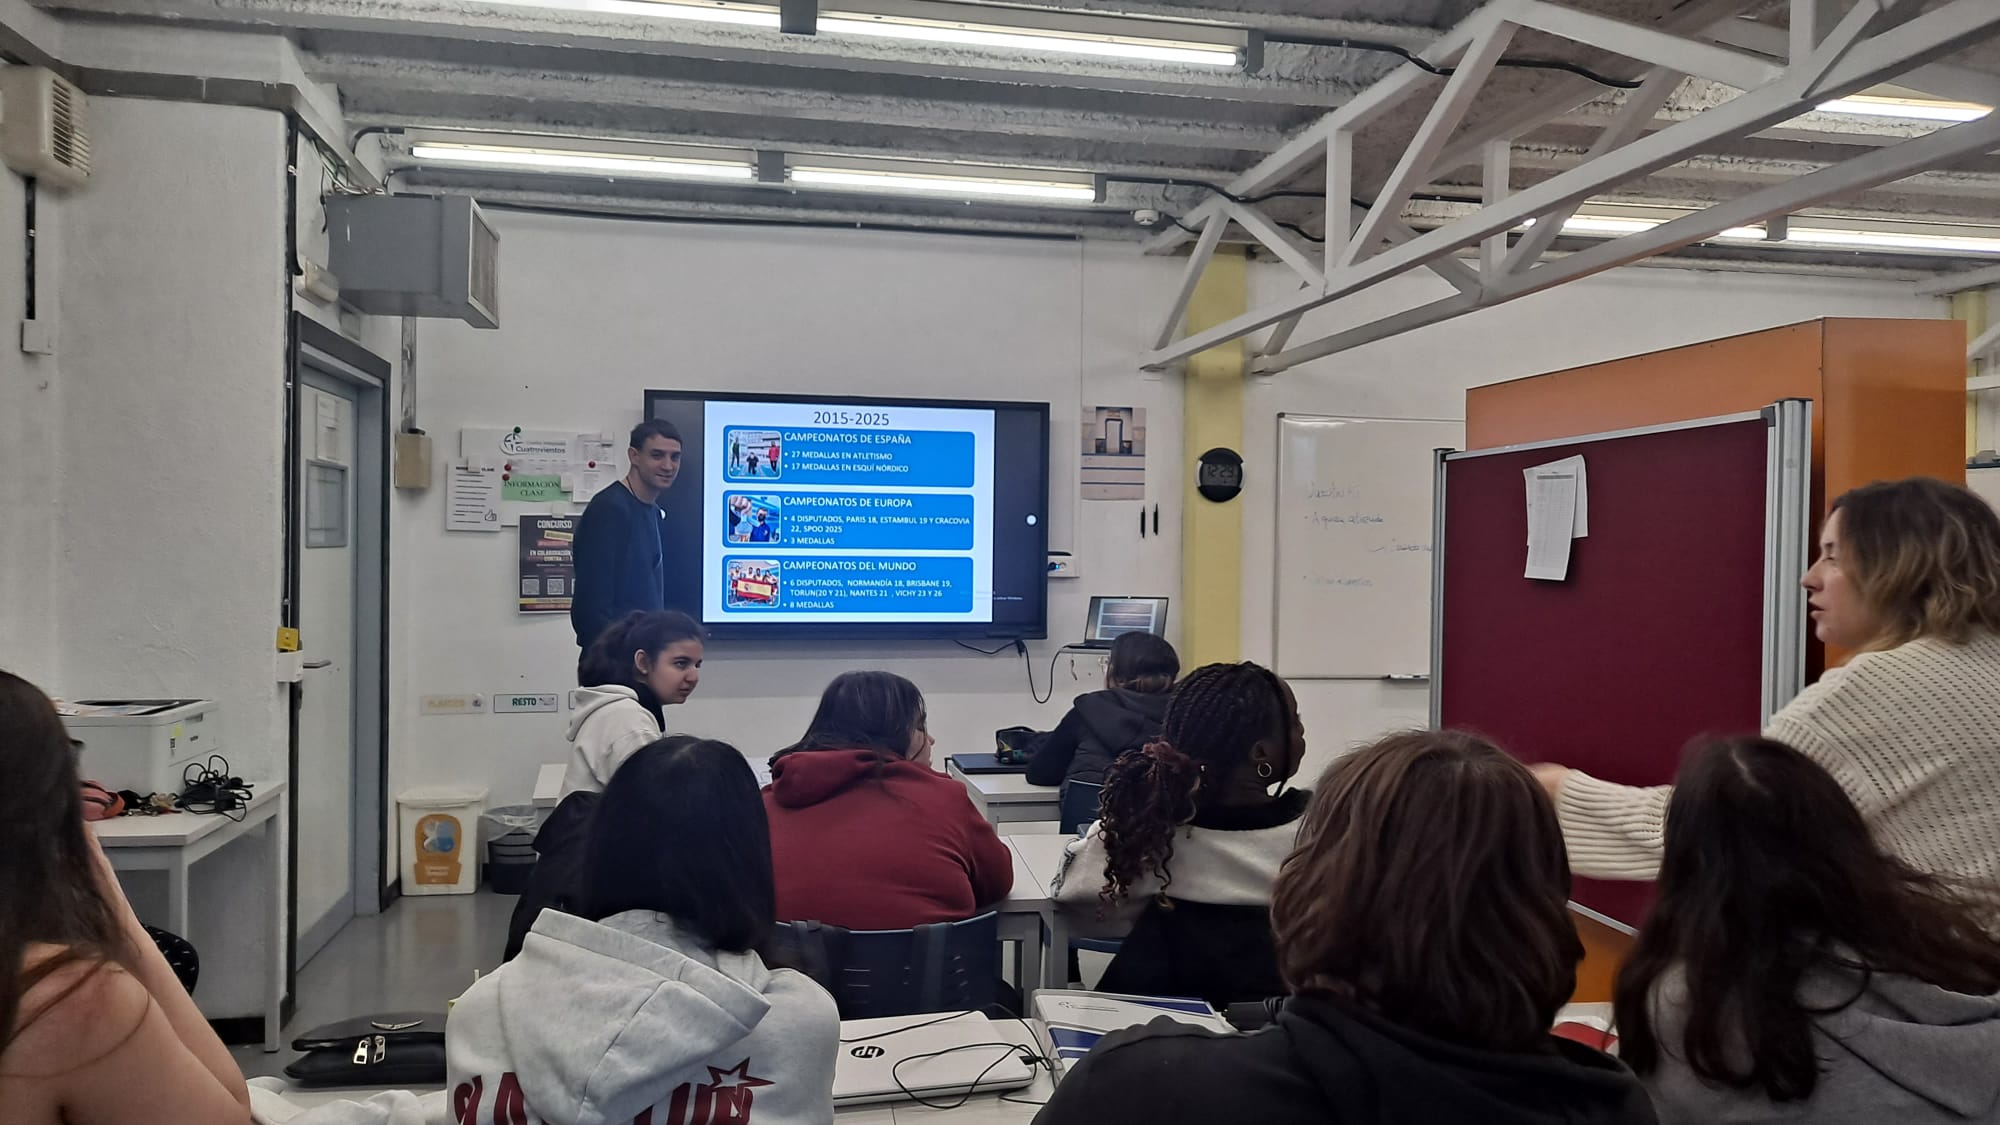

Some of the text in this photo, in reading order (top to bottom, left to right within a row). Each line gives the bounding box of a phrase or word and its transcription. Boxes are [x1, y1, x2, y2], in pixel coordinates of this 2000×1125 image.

[813, 411, 890, 426] 2015-2025
[784, 432, 912, 444] CAMPEONATOS DE ESPAÑA
[515, 445, 566, 454] Cuatrovientos
[802, 451, 840, 459] MEDALLAS
[842, 452, 851, 460] EN
[853, 452, 893, 460] ATLETISMO
[802, 463, 840, 471] MEDALLAS
[853, 463, 874, 472] ESQUÍ
[876, 463, 909, 472] NÓRDICO
[784, 496, 913, 508] CAMPEONATOS DE EUROPA
[537, 520, 573, 529] CONCURSO
[797, 515, 844, 524] DISPUTADOS,
[868, 516, 878, 524] 18,
[880, 516, 917, 525] ESTAMBUL
[935, 517, 970, 525] CRACOVIA
[791, 525, 843, 533] 22, SPOO 2025
[797, 537, 835, 545] MEDALLAS
[783, 561, 917, 571] CAMPEONATOS DEL MUNDO
[790, 578, 952, 588] 6 DISPUTADOS, NORMANDÍA 18, BRISBANE 19,
[850, 589, 878, 597] NANTES
[895, 589, 917, 597] VICHY
[796, 601, 835, 609] MEDALLAS
[512, 698, 537, 707] RESTO
[851, 1046, 885, 1059] hp
